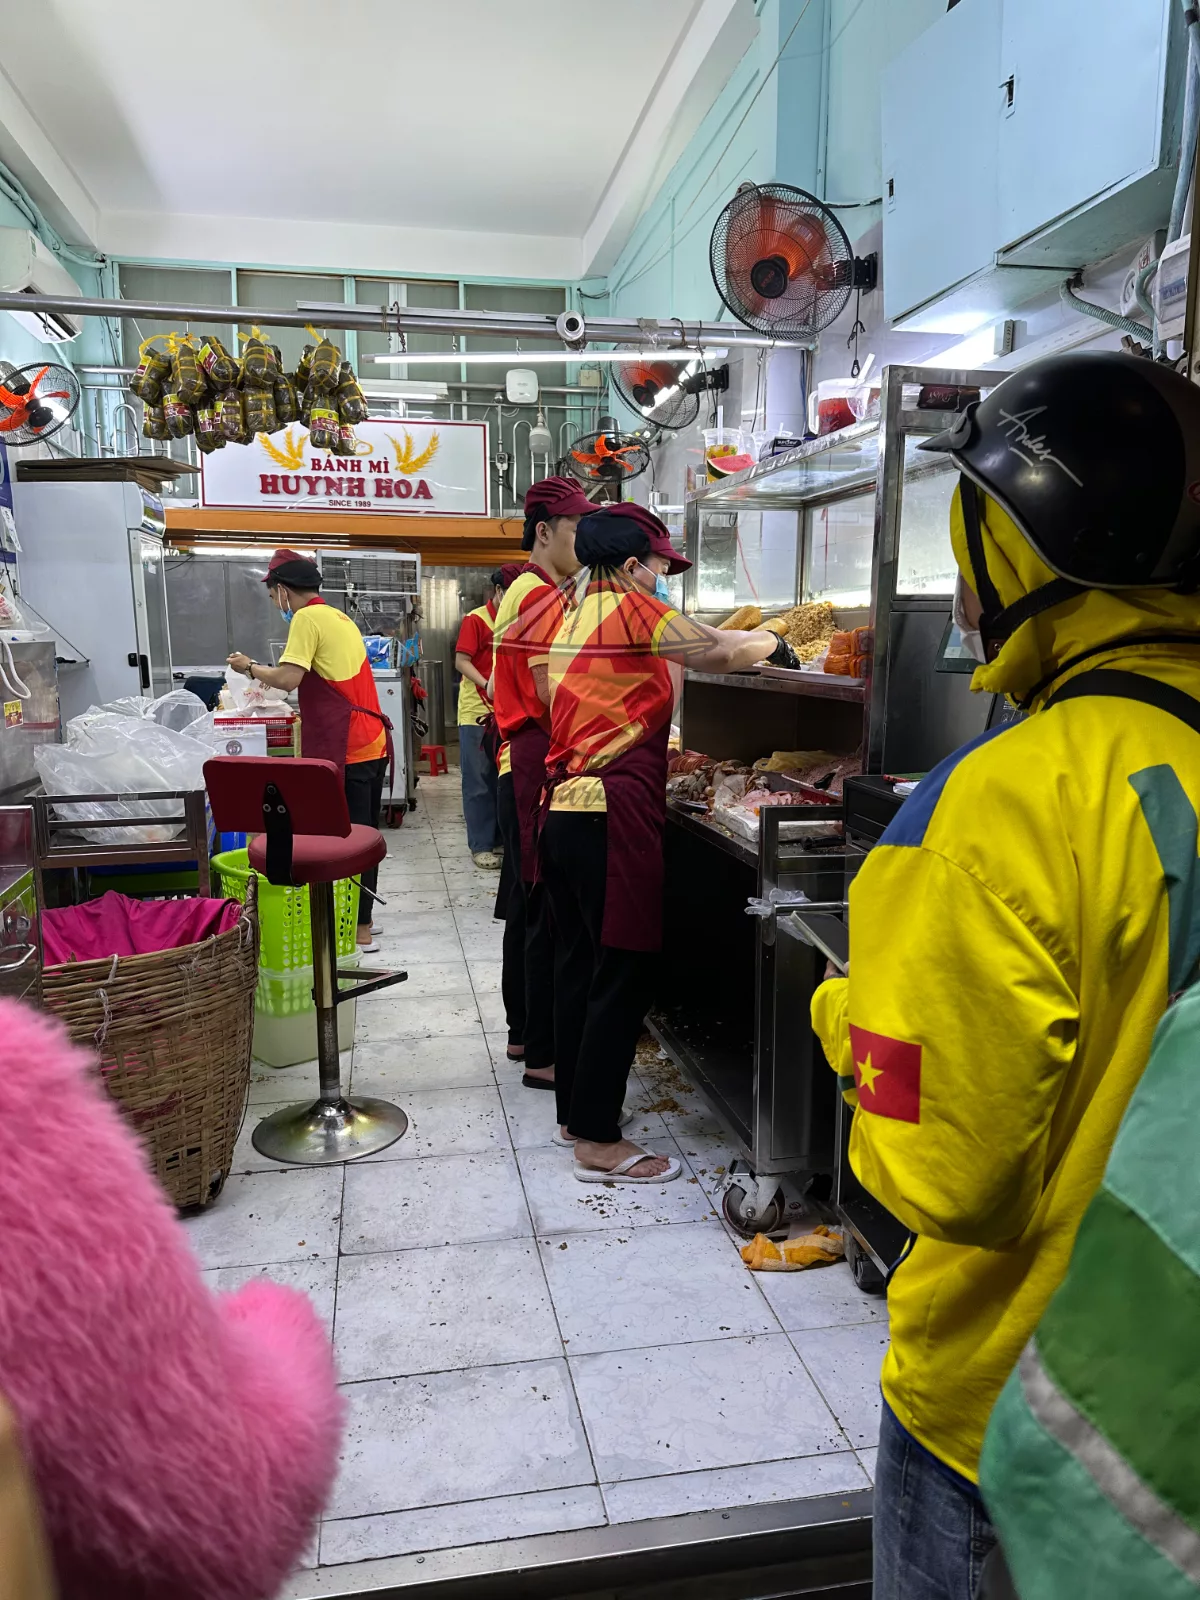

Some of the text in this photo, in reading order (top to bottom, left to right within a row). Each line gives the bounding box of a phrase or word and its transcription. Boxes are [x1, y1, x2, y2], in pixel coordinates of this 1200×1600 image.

[311, 455, 390, 473] BÁNH MÌ
[259, 474, 433, 499] HUYNH HOA
[328, 499, 352, 507] SINCE
